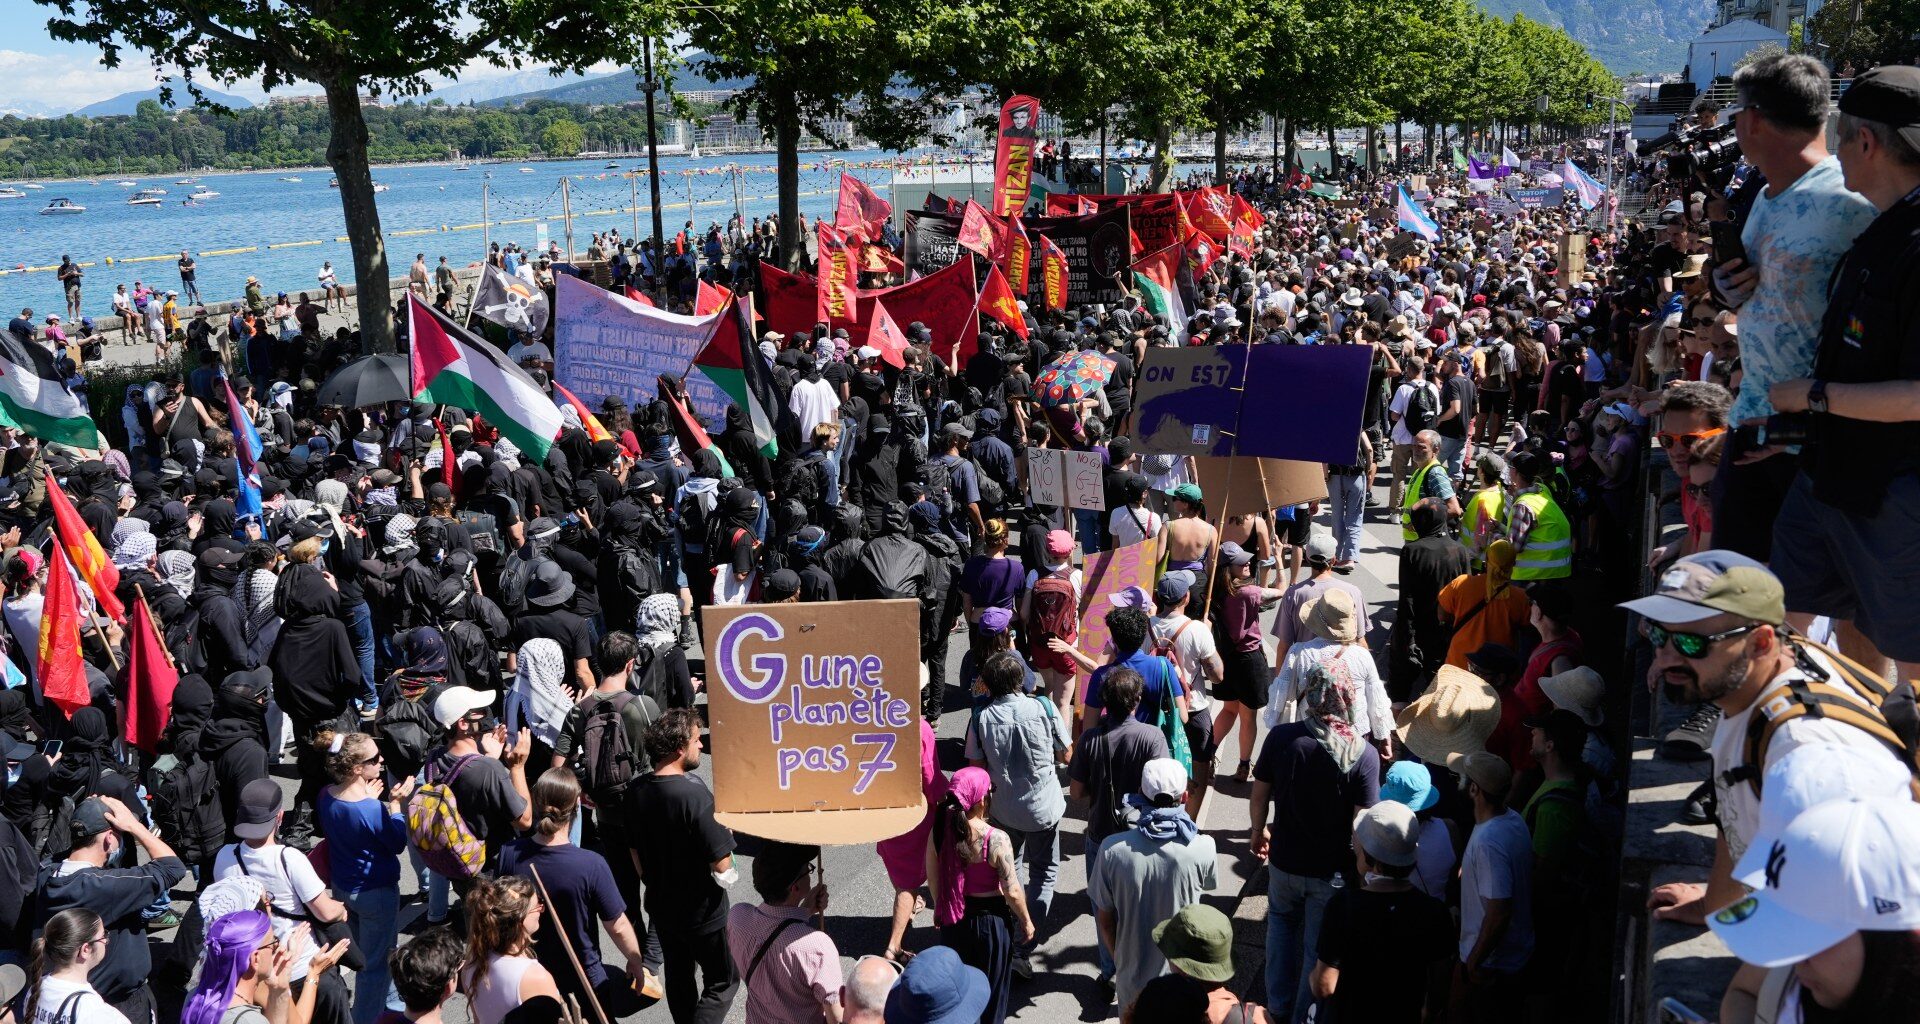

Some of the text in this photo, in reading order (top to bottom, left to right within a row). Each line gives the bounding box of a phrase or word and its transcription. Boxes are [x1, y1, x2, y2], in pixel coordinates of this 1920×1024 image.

[1003, 144, 1030, 216] TIZAN
[829, 250, 847, 317] PARTIZAN
[1009, 235, 1025, 290] PARTIZAN
[1146, 365, 1229, 385] ON EST
[1032, 463, 1053, 489] NO
[714, 612, 883, 704] G une
[769, 684, 912, 745] planète
[777, 733, 897, 796] pas 7
